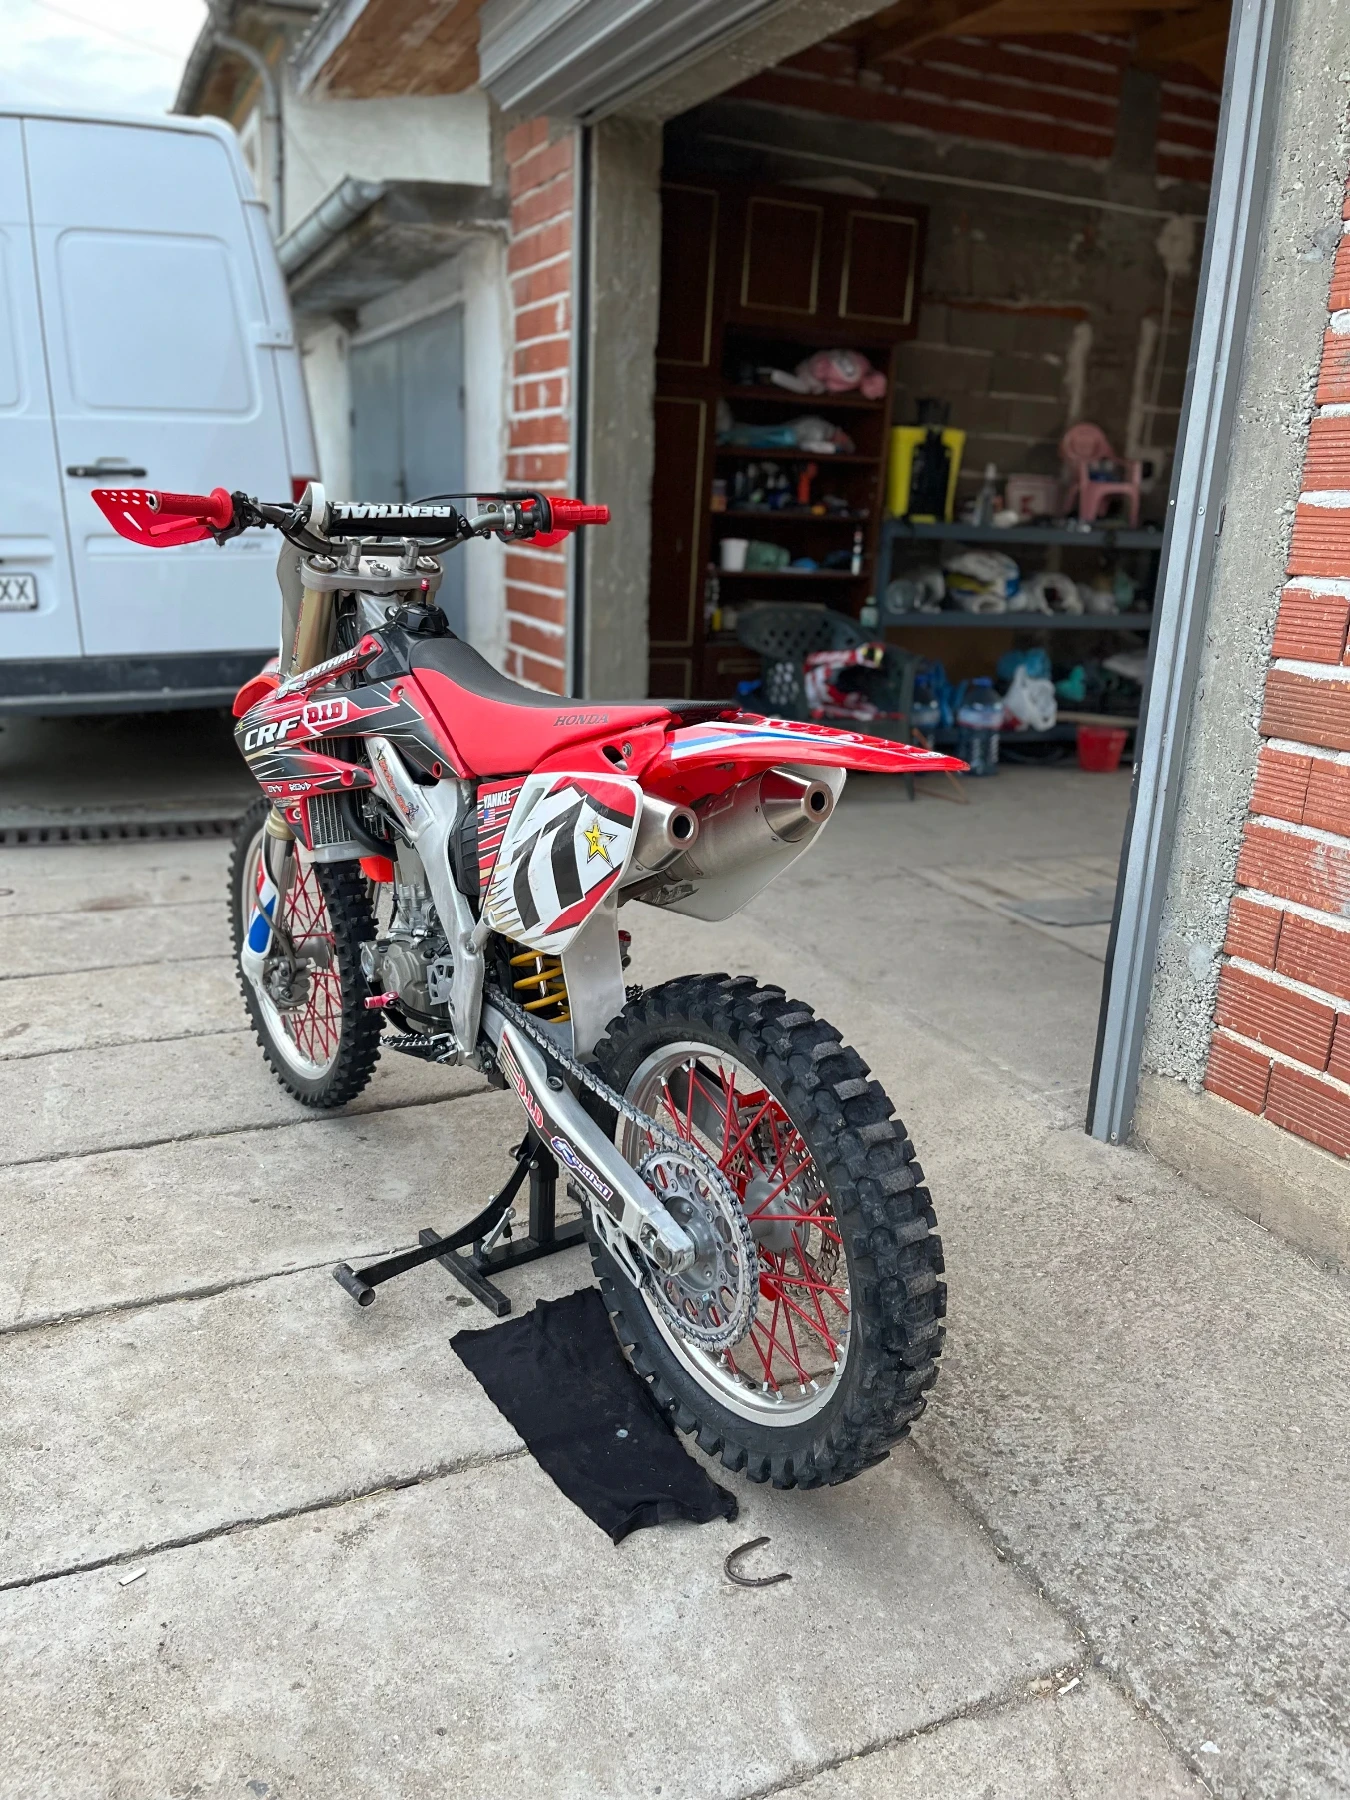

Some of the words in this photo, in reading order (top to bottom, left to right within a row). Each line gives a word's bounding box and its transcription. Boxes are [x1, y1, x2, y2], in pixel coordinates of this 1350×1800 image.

[334, 504, 451, 519] RENTHAL
[553, 713, 609, 727] HONDA
[244, 715, 301, 751] CRF
[483, 788, 511, 810] YANKEE
